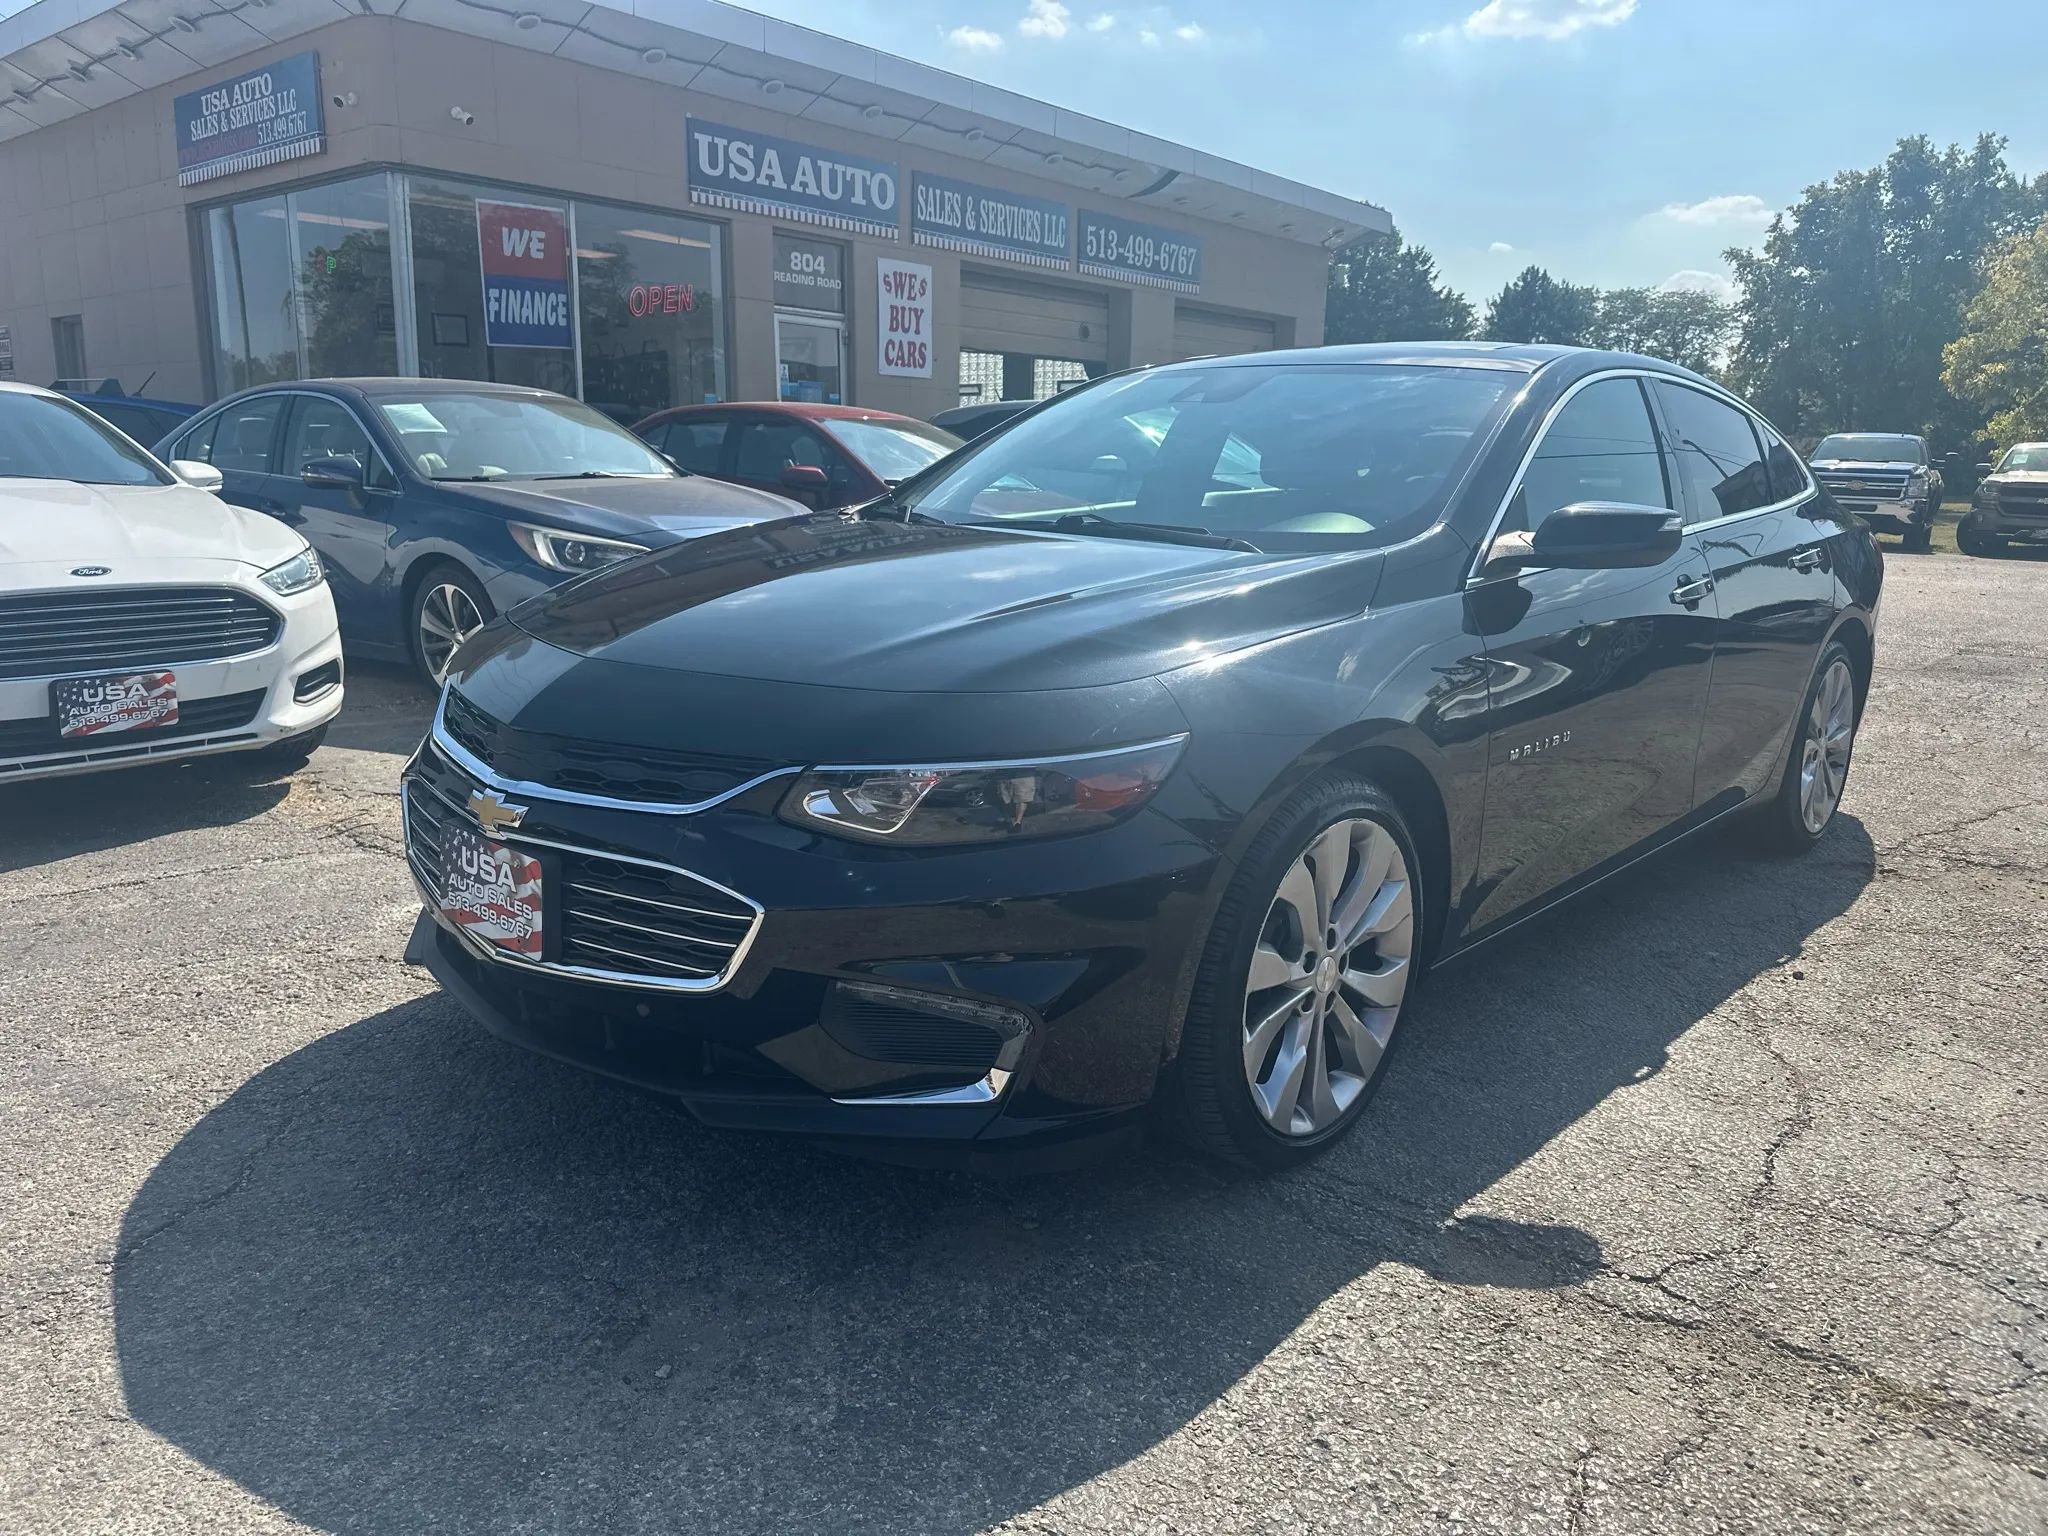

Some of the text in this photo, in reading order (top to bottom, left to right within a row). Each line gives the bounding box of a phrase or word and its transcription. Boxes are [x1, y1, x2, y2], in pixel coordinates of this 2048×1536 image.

[201, 73, 272, 116] USA AUTO
[190, 88, 297, 141] SALES & SERVICES LLC
[257, 111, 307, 145] 513.499.6767
[694, 132, 895, 210] USA AUTO
[917, 184, 1066, 249] SALES & SERVICES LLC
[502, 226, 546, 259] WE
[1086, 225, 1197, 276] 513-499-6767
[790, 251, 826, 275] 804
[774, 271, 842, 290] READING ROAD
[488, 288, 567, 327] FINANCE
[629, 284, 693, 317] OPEN
[888, 304, 925, 335] BUY
[884, 338, 928, 370] CARS
[69, 698, 168, 717] AUTO SALES
[82, 683, 150, 703] USA
[1509, 731, 1571, 761] MALIBU
[461, 845, 517, 893] USA
[448, 873, 533, 920] AUTO SALES
